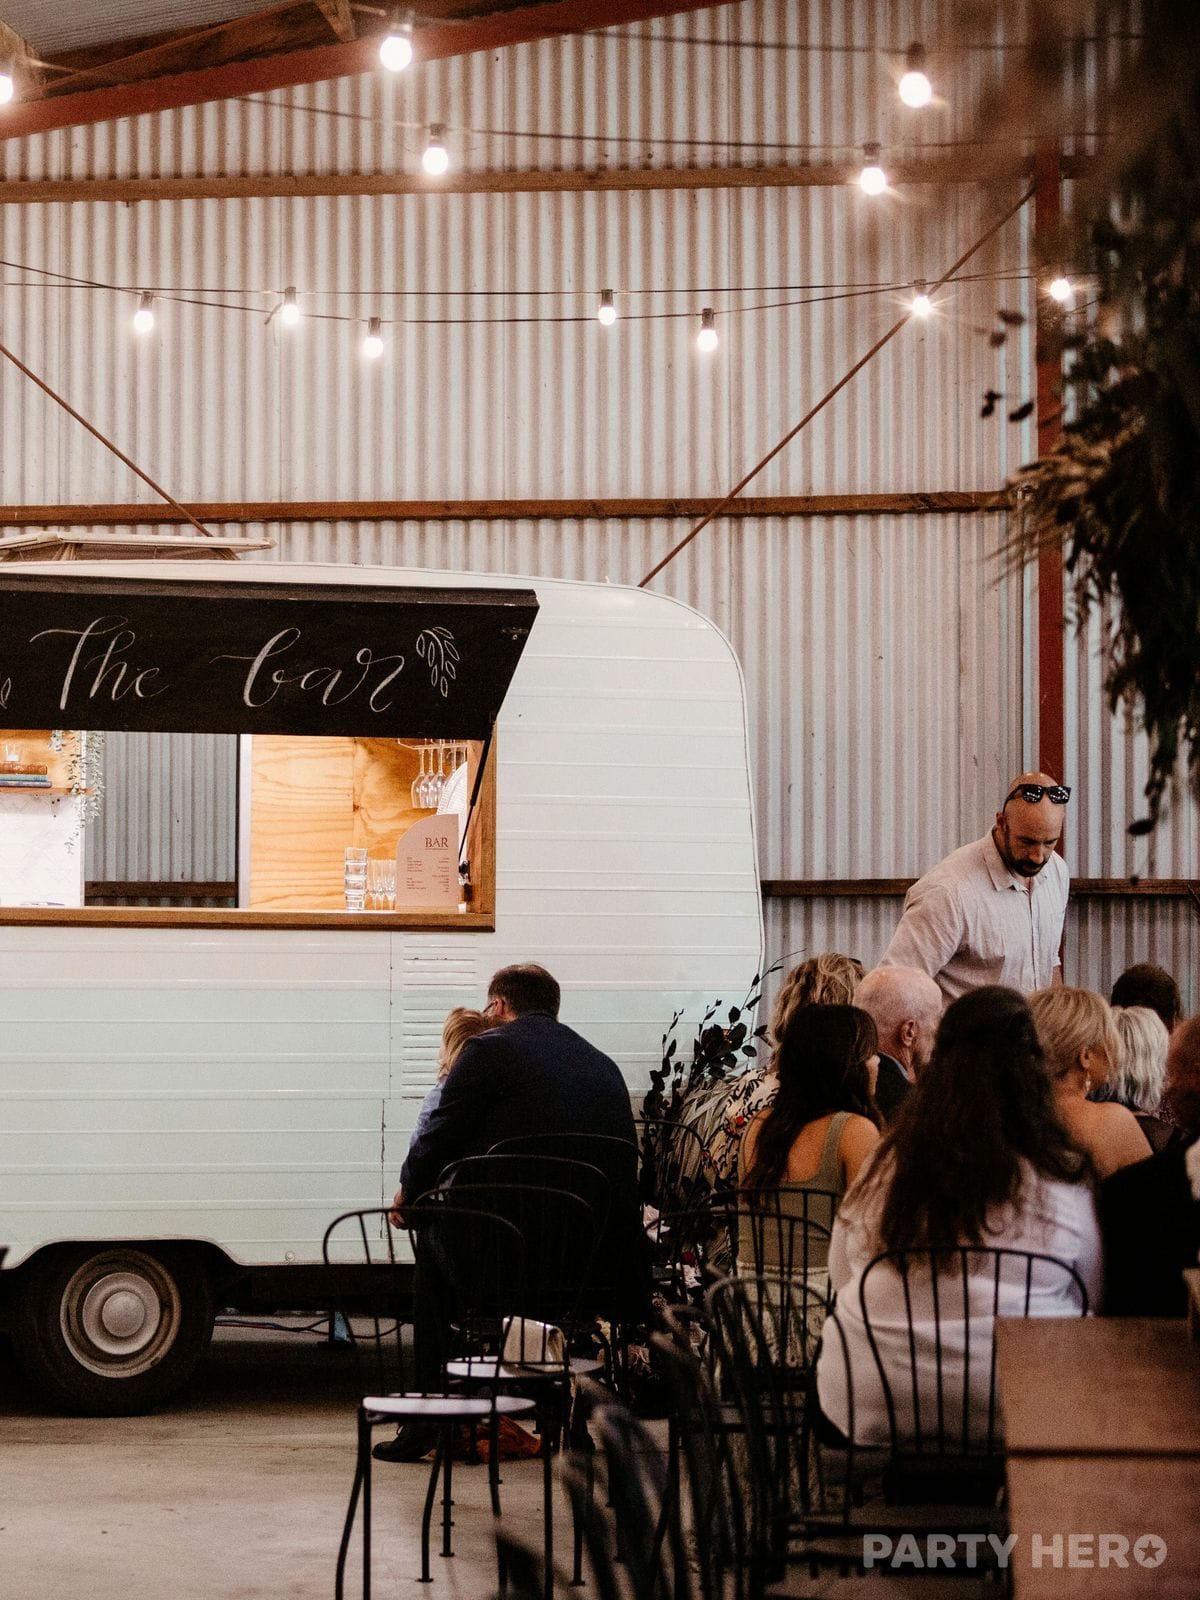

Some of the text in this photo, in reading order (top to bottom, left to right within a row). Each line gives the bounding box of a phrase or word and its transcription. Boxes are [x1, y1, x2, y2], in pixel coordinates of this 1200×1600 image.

[30, 615, 404, 712] The bar
[425, 836, 449, 848] BAR
